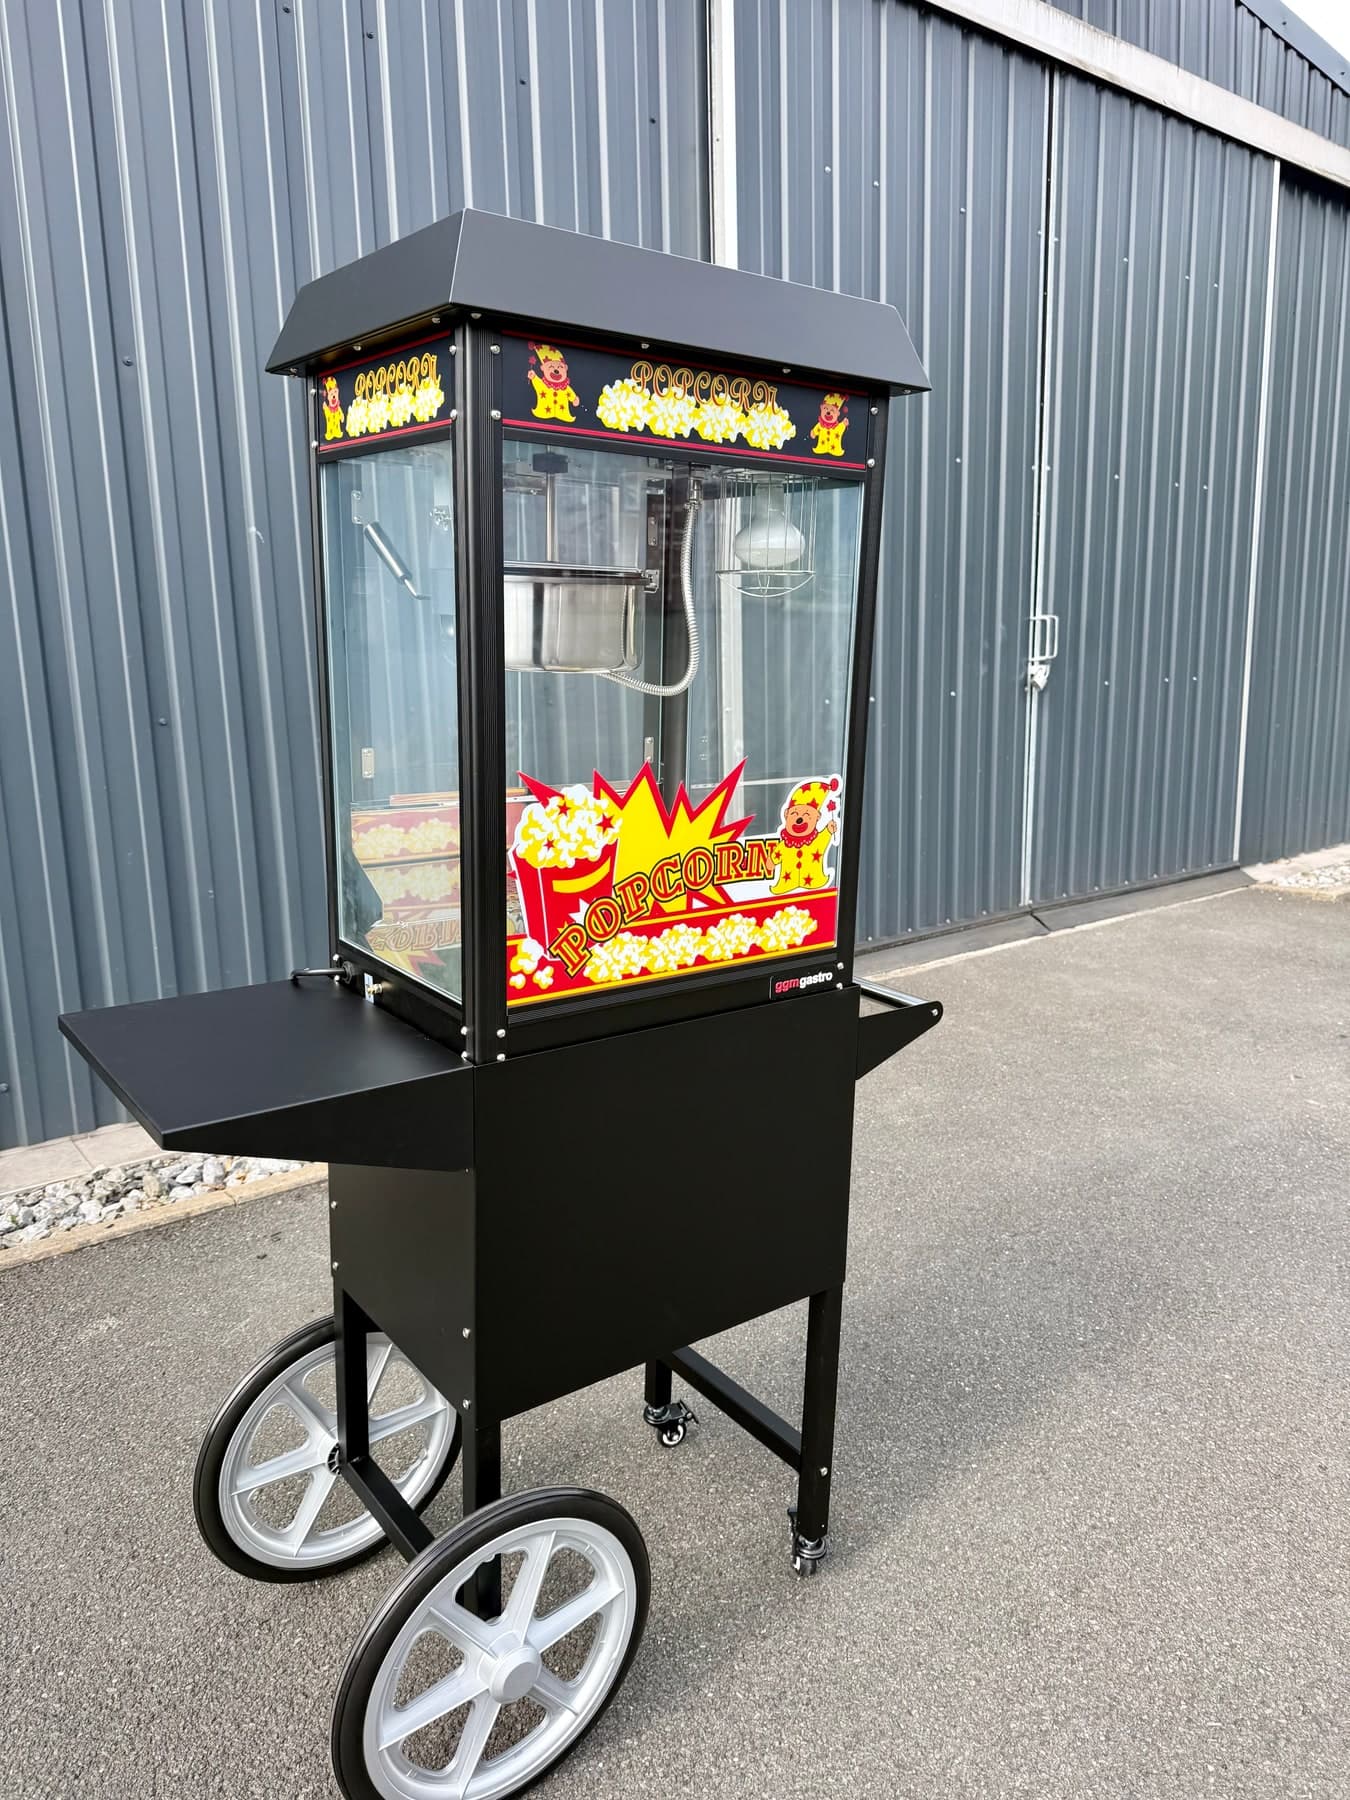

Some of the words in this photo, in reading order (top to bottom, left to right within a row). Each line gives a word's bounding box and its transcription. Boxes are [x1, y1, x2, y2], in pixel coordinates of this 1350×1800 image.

[354, 352, 442, 403] POPCORN
[630, 360, 781, 415] POPCORN
[549, 838, 780, 978] POPCORN
